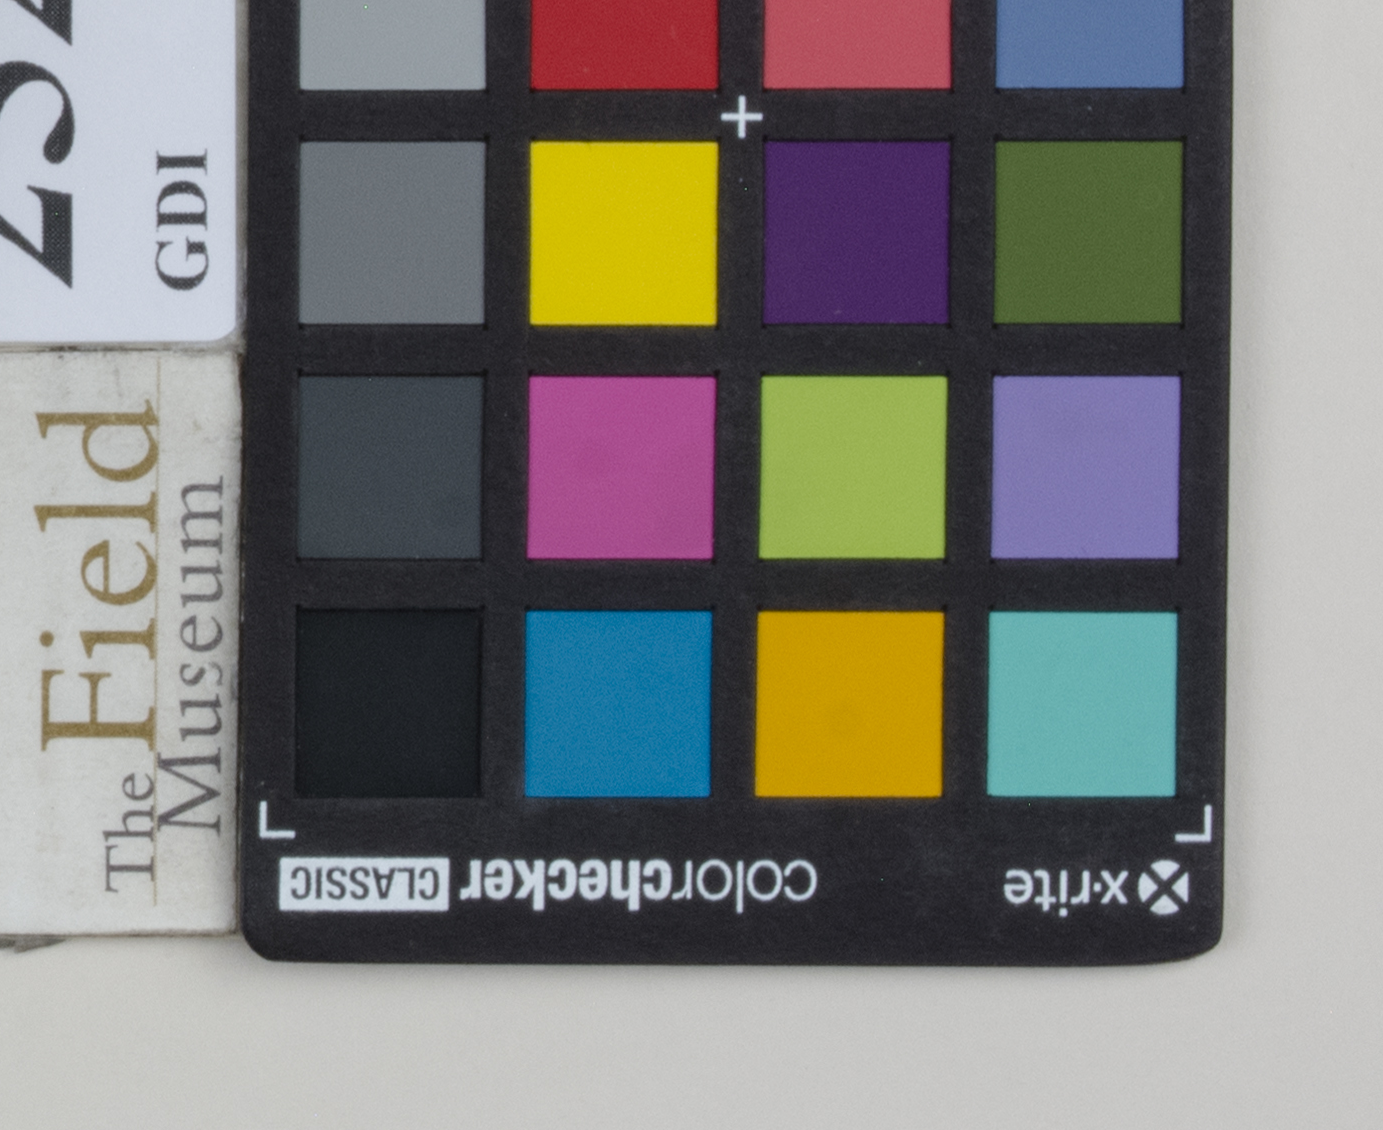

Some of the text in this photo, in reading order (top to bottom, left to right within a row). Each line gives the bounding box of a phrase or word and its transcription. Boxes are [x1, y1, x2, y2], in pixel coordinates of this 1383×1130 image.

[154, 149, 209, 292] GDI
[33, 398, 160, 893] The Field
[158, 475, 224, 838] Museum
[290, 858, 818, 914] colorchecker CLASSIC
